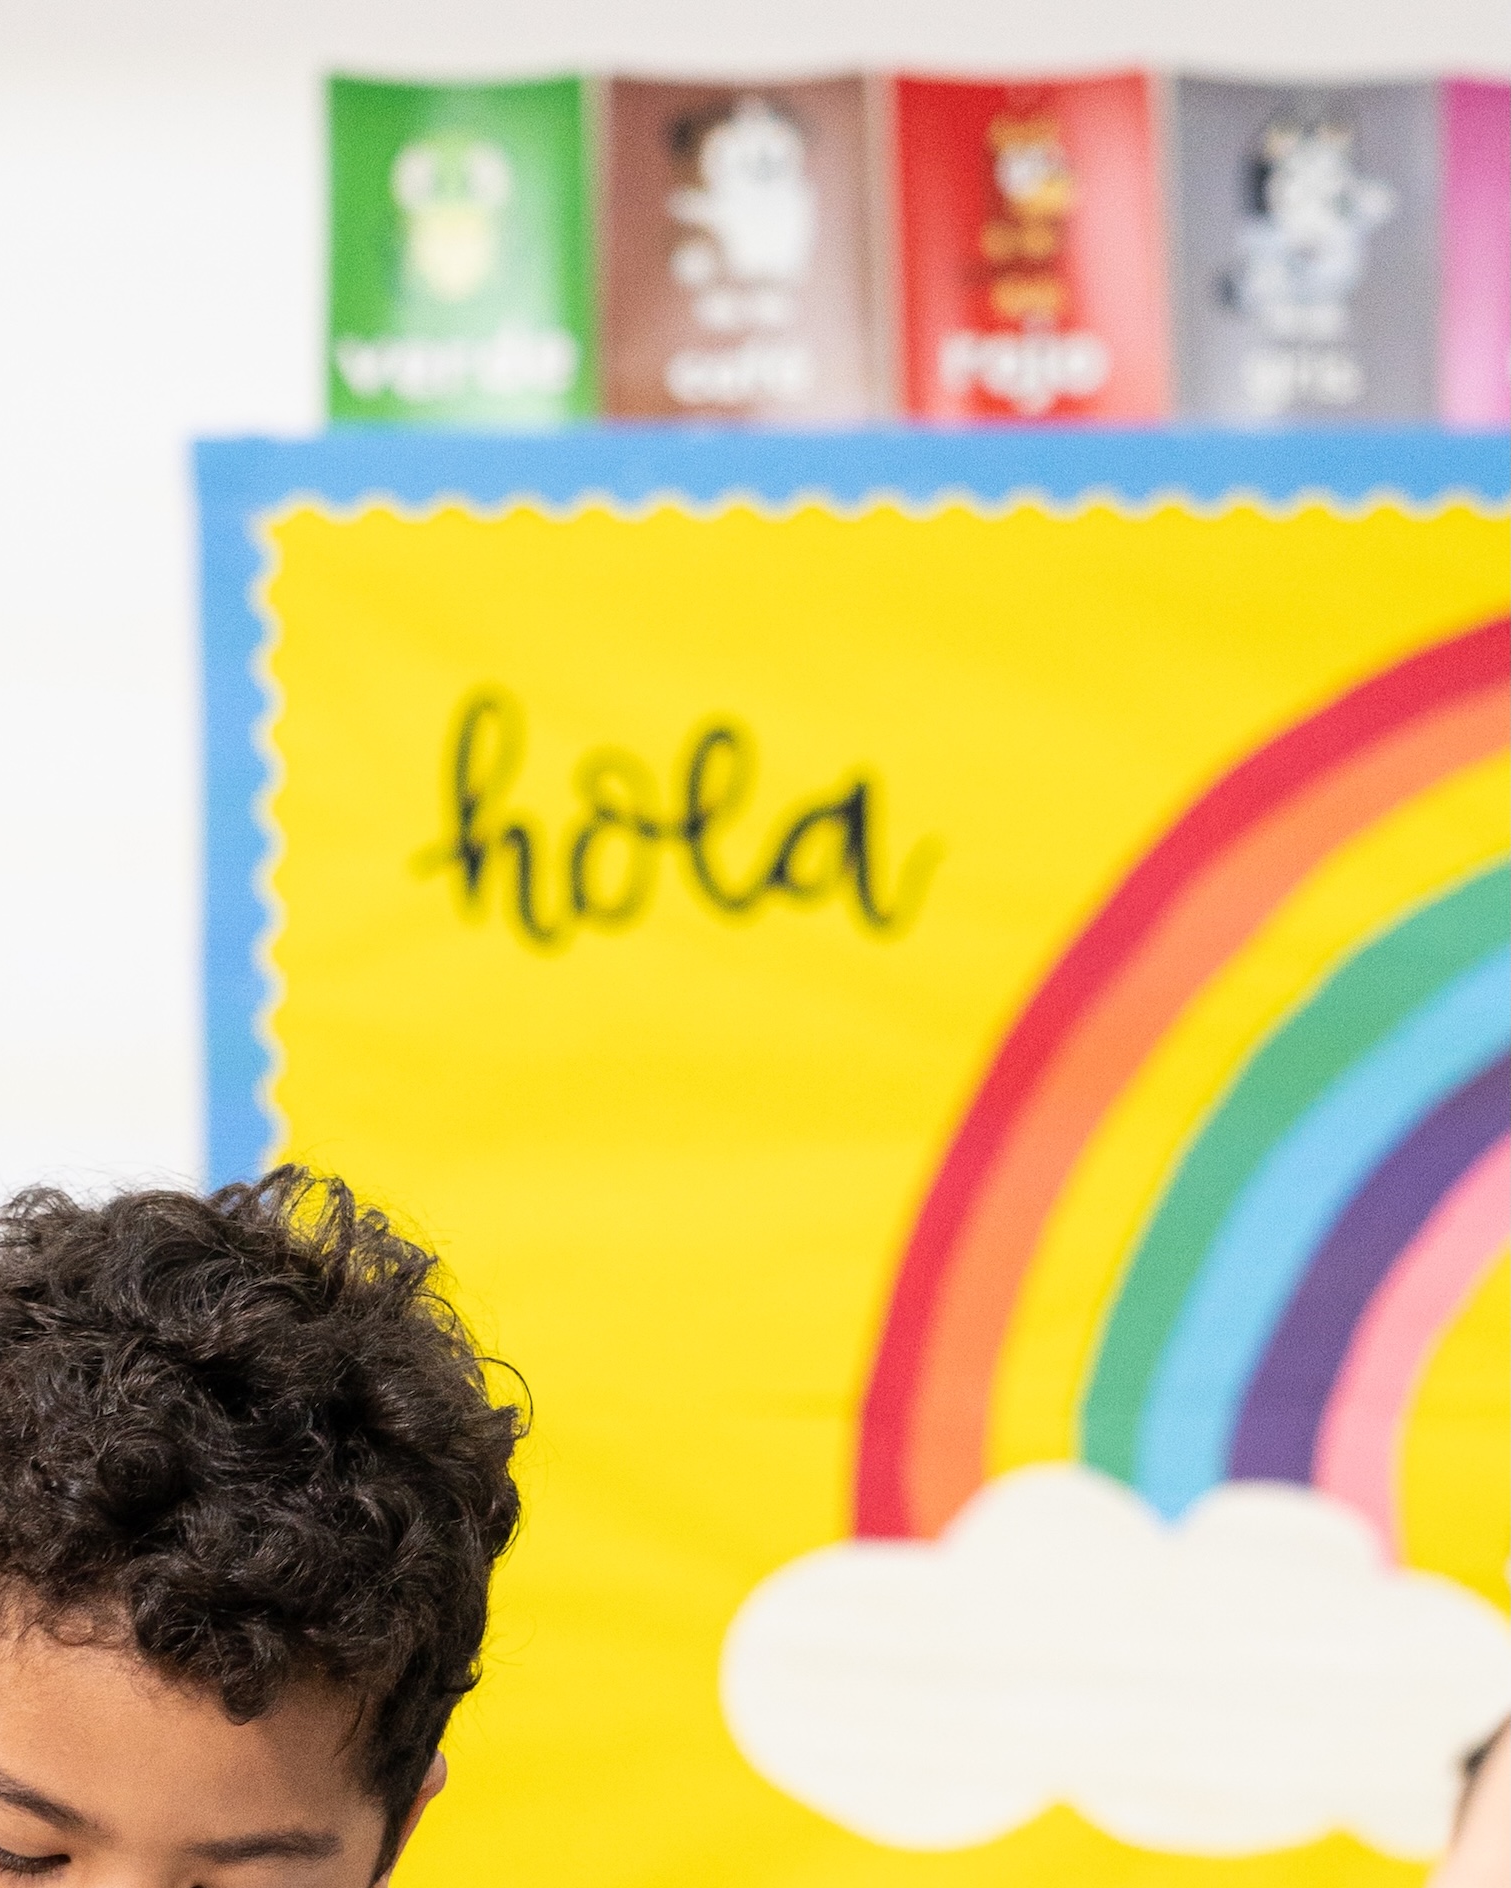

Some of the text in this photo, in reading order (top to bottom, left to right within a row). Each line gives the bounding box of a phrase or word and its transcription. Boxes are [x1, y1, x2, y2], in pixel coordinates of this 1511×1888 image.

[338, 324, 577, 398] verde
[940, 326, 1107, 411] rojo
[412, 688, 943, 946] hola
